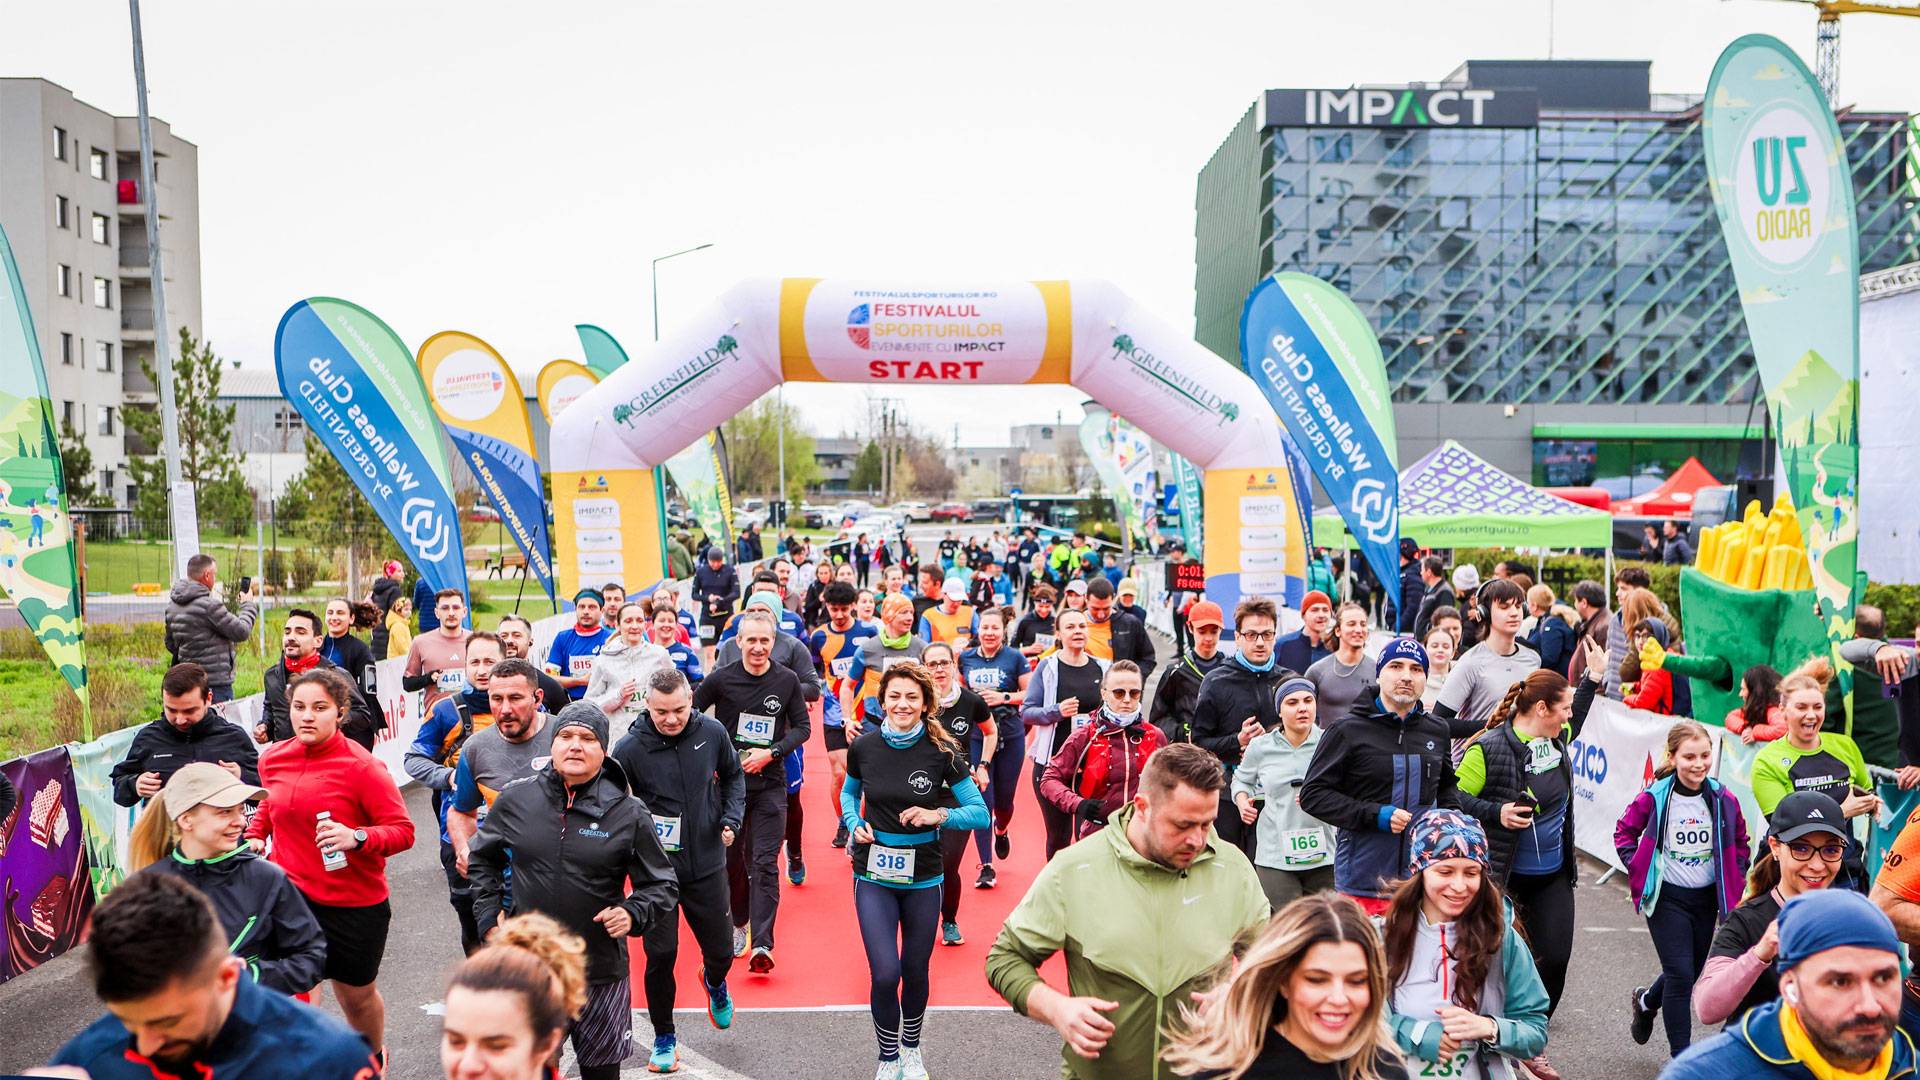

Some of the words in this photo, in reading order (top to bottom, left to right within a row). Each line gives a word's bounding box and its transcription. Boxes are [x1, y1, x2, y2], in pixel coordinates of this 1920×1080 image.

[1305, 90, 1495, 125] IMPACT
[874, 303, 981, 317] FESTIVALUL
[873, 322, 1002, 338] SPORTURILOR
[872, 341, 933, 352] EVENIMENTE
[936, 342, 950, 352] CU
[954, 342, 1005, 352] IMPACT
[869, 360, 984, 380] START
[630, 348, 722, 412] GREENFIELD
[1131, 347, 1223, 411] GREENFIELD
[1427, 522, 1530, 536] www.sportguru.ro
[573, 660, 592, 670] 815
[442, 673, 461, 682] 441
[975, 674, 993, 684] 431
[744, 720, 769, 734] 451
[1535, 743, 1551, 759] 120
[1795, 774, 1834, 788] GREENFIELD
[1290, 835, 1319, 851] 166
[1675, 830, 1709, 845] 900
[876, 853, 905, 870] 318
